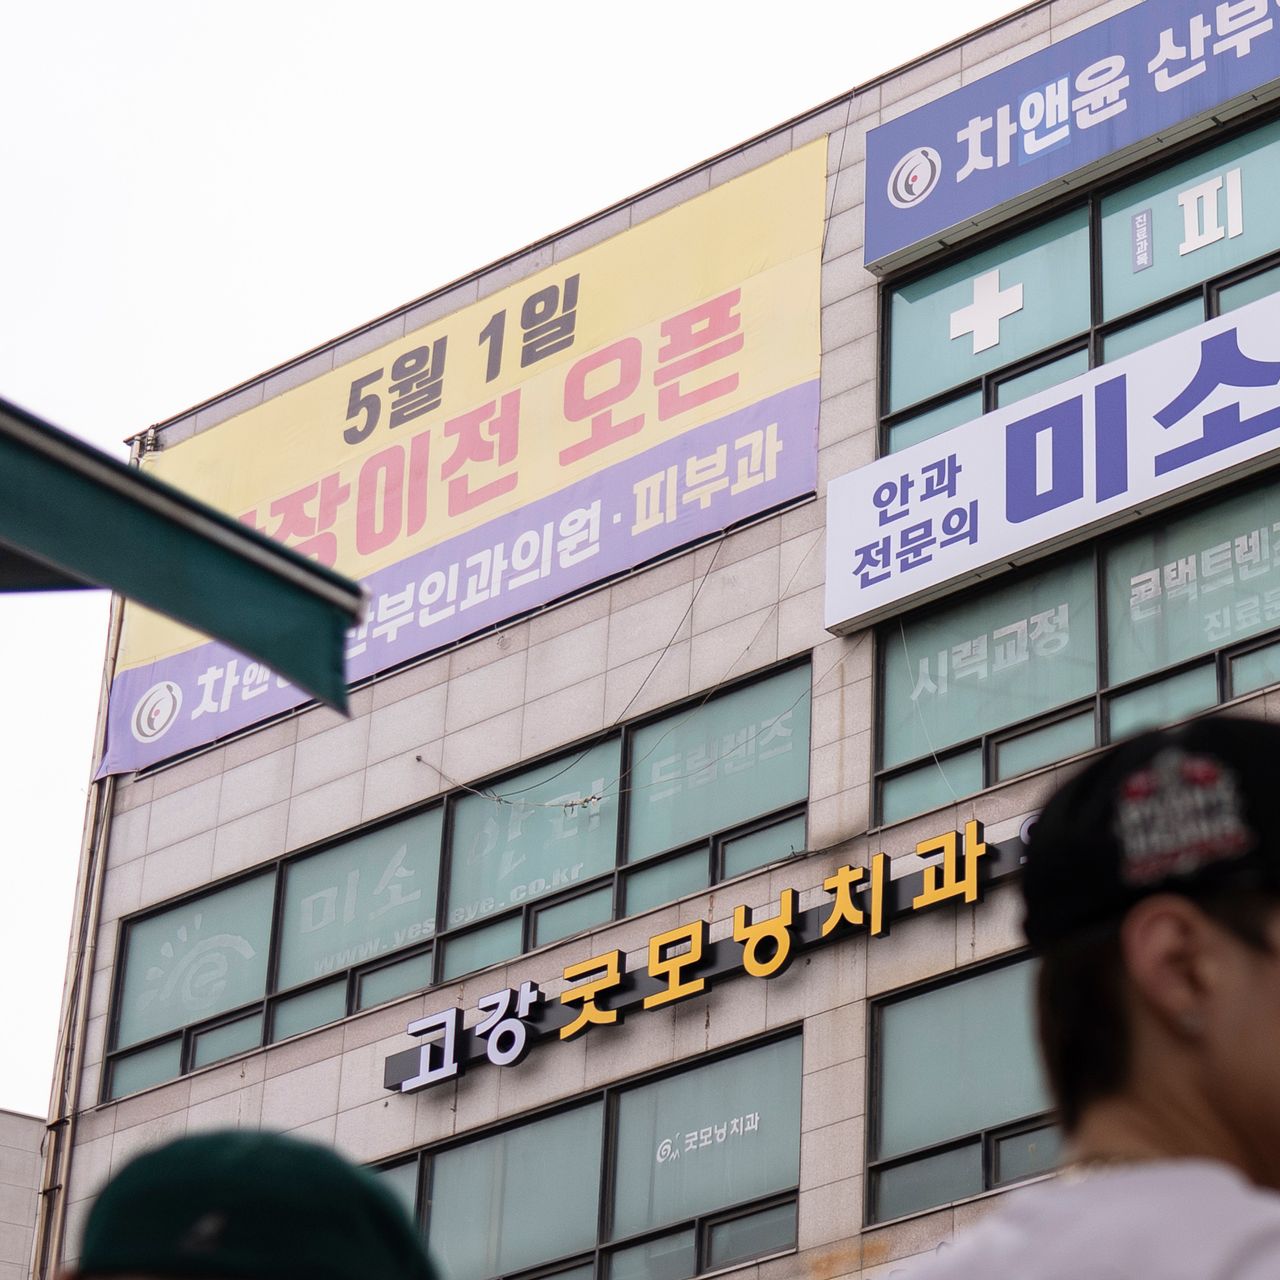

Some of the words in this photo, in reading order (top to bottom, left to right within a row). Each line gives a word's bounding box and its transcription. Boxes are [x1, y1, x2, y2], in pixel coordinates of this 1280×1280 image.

[956, 55, 1130, 184] 차앤윤
[343, 336, 447, 446] 5월
[478, 273, 581, 384] 1일
[240, 390, 521, 571] 장이전
[559, 288, 745, 467] 오픈
[872, 453, 963, 528] 안과
[191, 657, 292, 721] 차앤
[630, 423, 784, 536] 피부과
[853, 506, 980, 590] 전문의
[909, 602, 1070, 703] 시력교정
